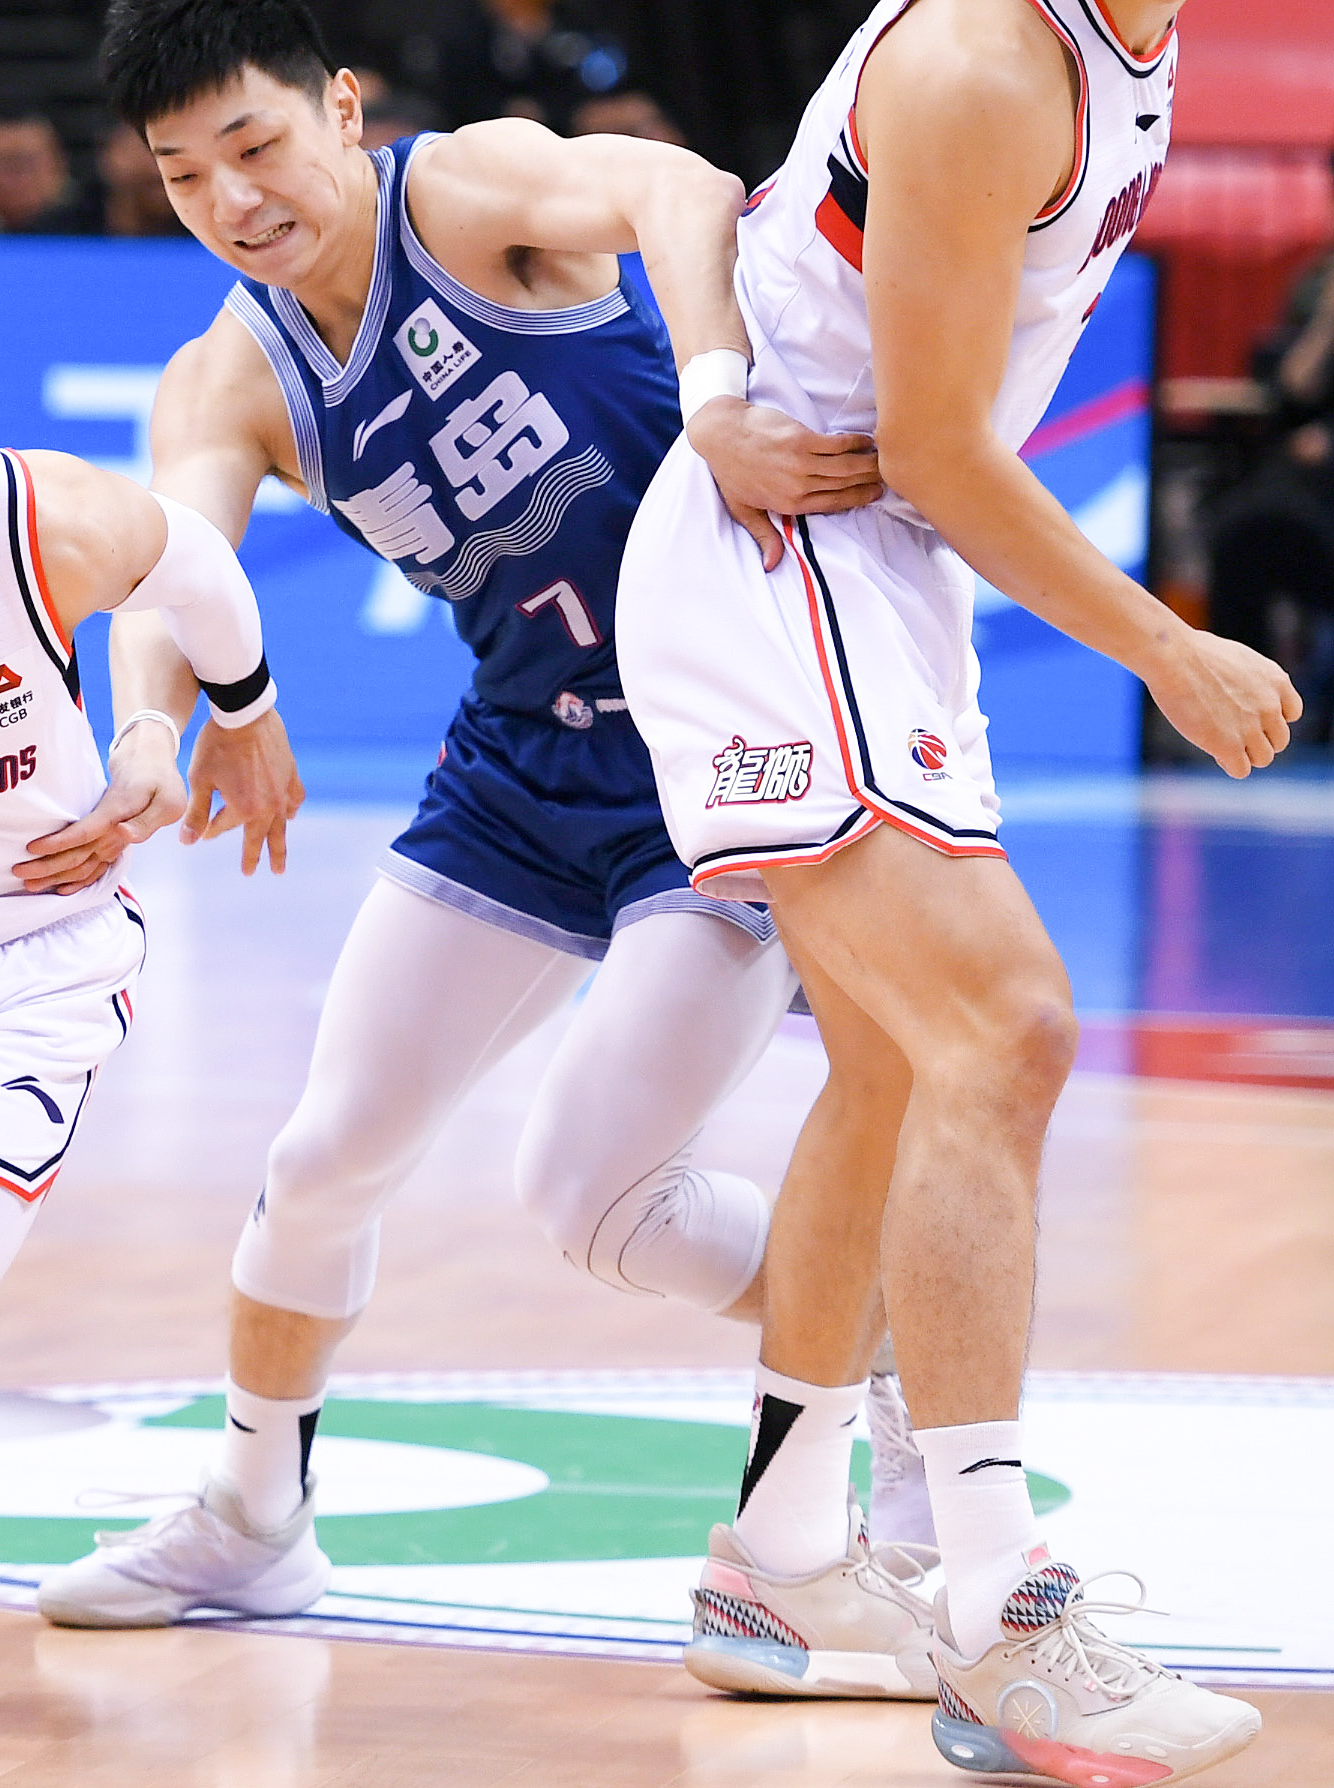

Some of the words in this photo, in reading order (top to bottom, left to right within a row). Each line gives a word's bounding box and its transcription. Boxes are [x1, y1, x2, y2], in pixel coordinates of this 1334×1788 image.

[422, 340, 465, 383] 中国人寿
[430, 367, 454, 391] CHINA
[453, 350, 472, 368] LIFE
[330, 370, 570, 565] 青岛
[515, 578, 603, 648] 7
[0, 708, 27, 728] CGB
[922, 771, 954, 782] CBA
